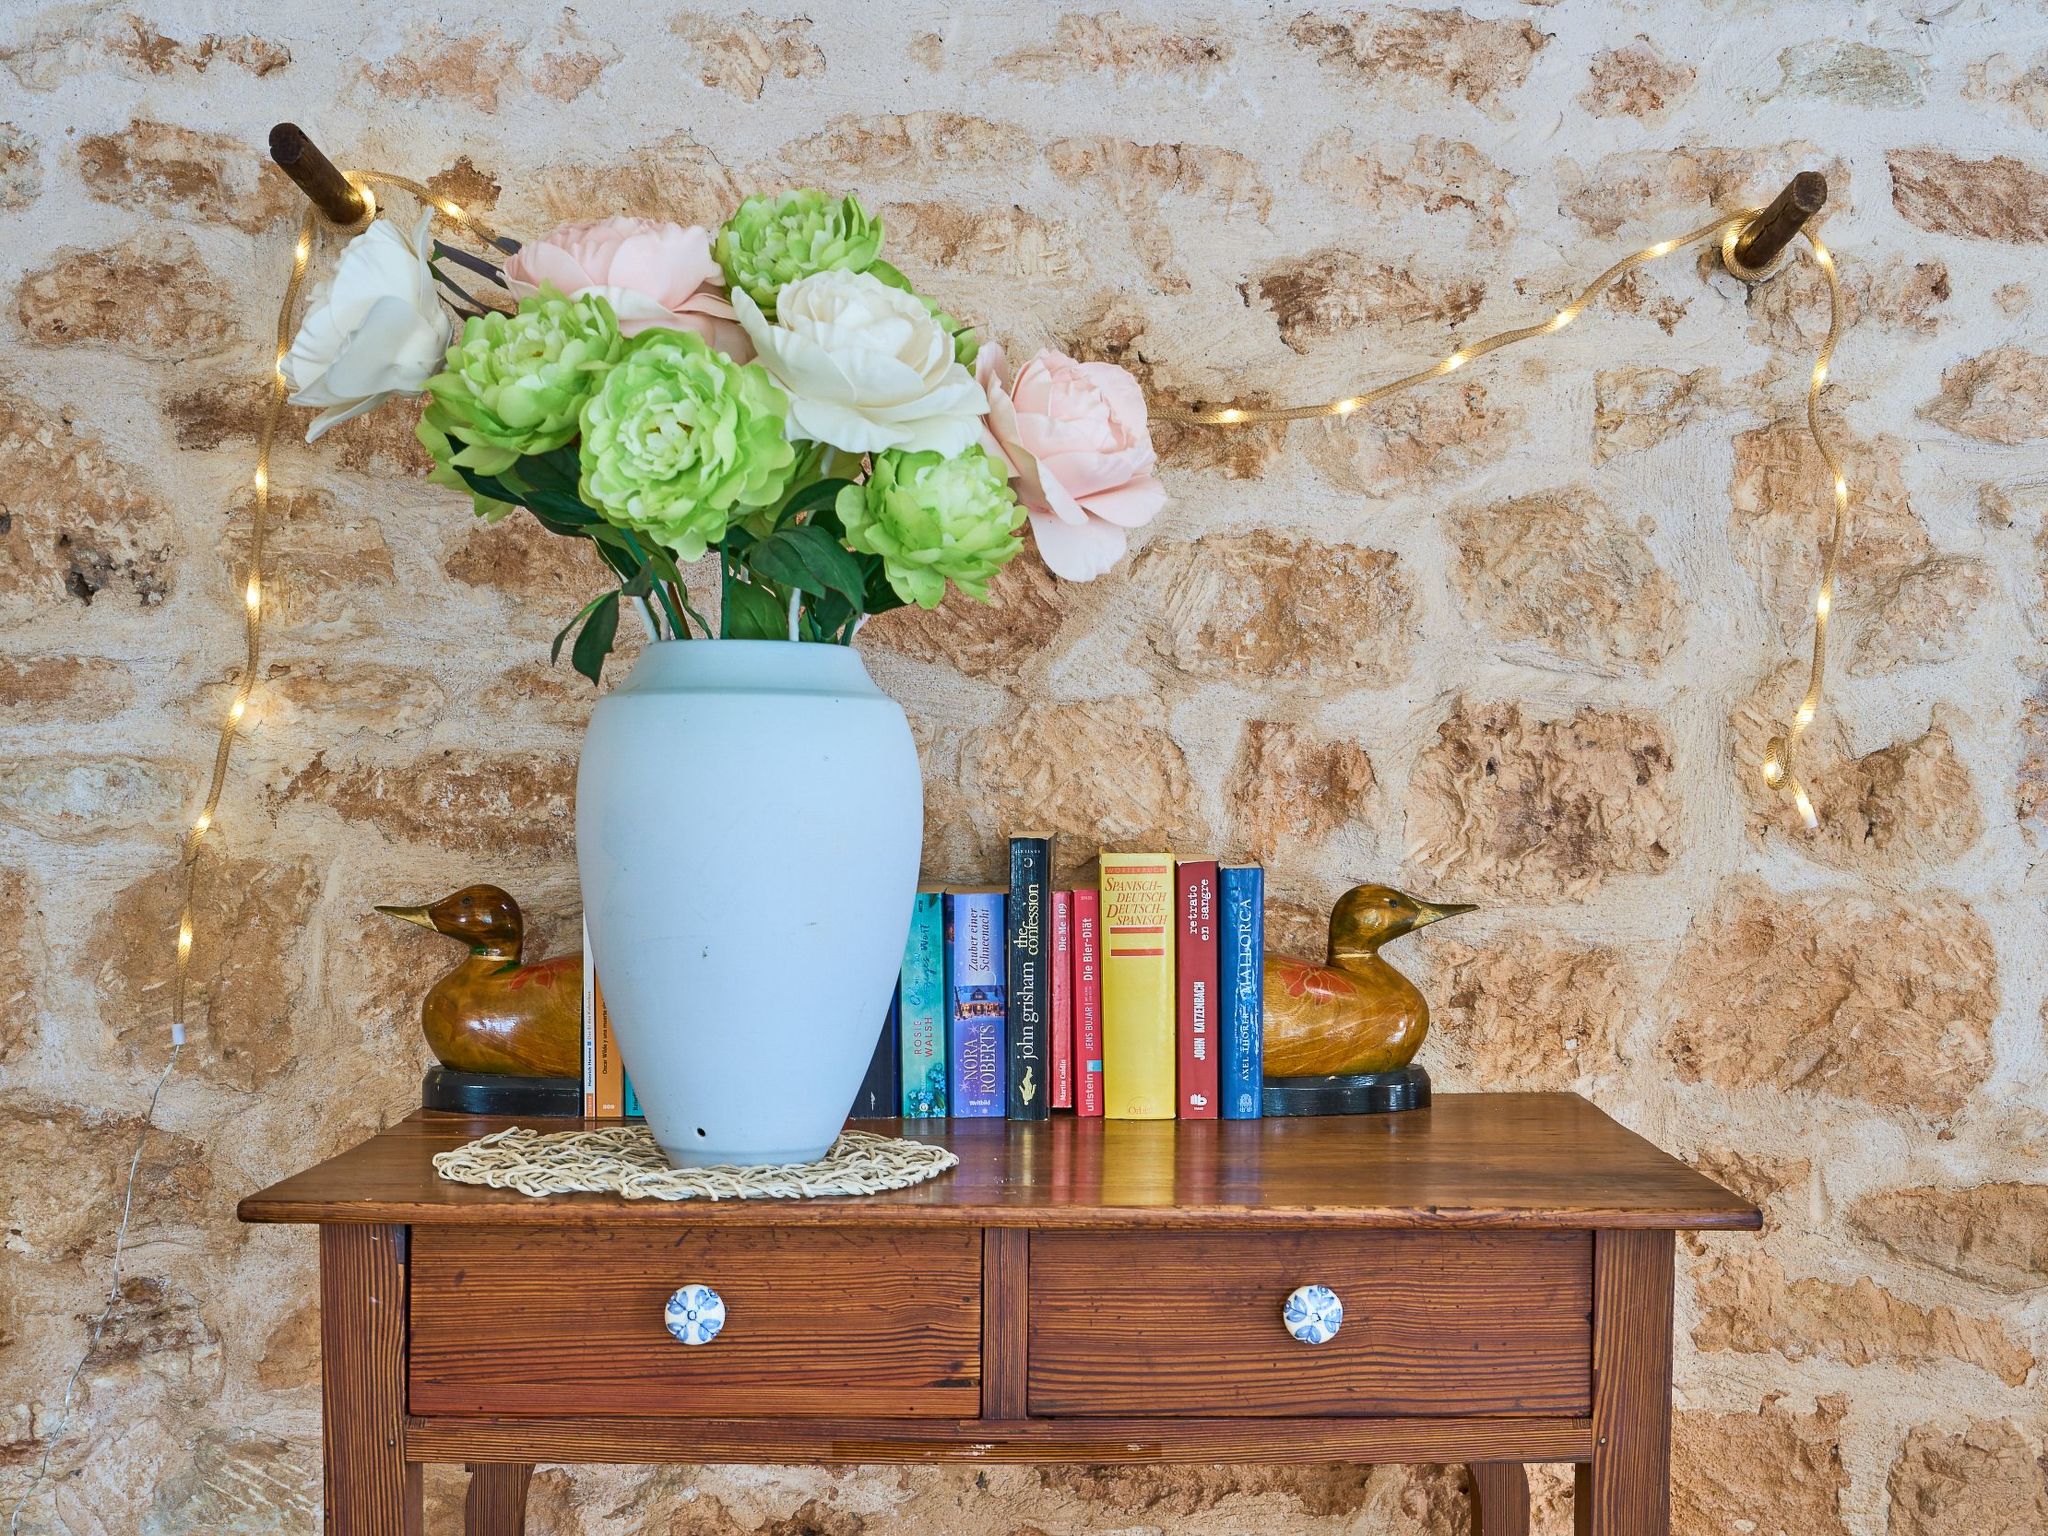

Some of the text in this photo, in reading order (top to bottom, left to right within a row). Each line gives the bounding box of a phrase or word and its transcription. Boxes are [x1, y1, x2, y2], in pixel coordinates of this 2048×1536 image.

[1105, 877, 1162, 892] SPANISCH-
[1116, 892, 1168, 903] DEUTSCH
[1022, 883, 1039, 956] confession
[1058, 903, 1068, 919] 109
[1106, 903, 1165, 918] DEUTSCH-
[1116, 914, 1168, 925] SPANISCH
[1188, 885, 1198, 935] retrato
[1199, 879, 1211, 941] en sangre
[968, 907, 979, 972] Zauber einer
[980, 908, 990, 972] Schneenacht
[1013, 927, 1028, 949] the
[1058, 936, 1068, 951] Die
[1081, 918, 1093, 962] Bier-Diät
[1239, 898, 1252, 994] MALLORCA
[1083, 965, 1093, 981] Die
[1017, 961, 1039, 1061] john grisham
[1194, 981, 1205, 1061] JOHN KATZENBACH
[913, 1020, 922, 1055] ROSIE
[924, 1017, 933, 1057] WALSH
[1085, 1032, 1094, 1051] JENS
[964, 1038, 978, 1080] NORA
[979, 1024, 996, 1093] ROBERTS
[969, 1099, 991, 1107] Weltbild
[1085, 1074, 1095, 1111] ullstein
